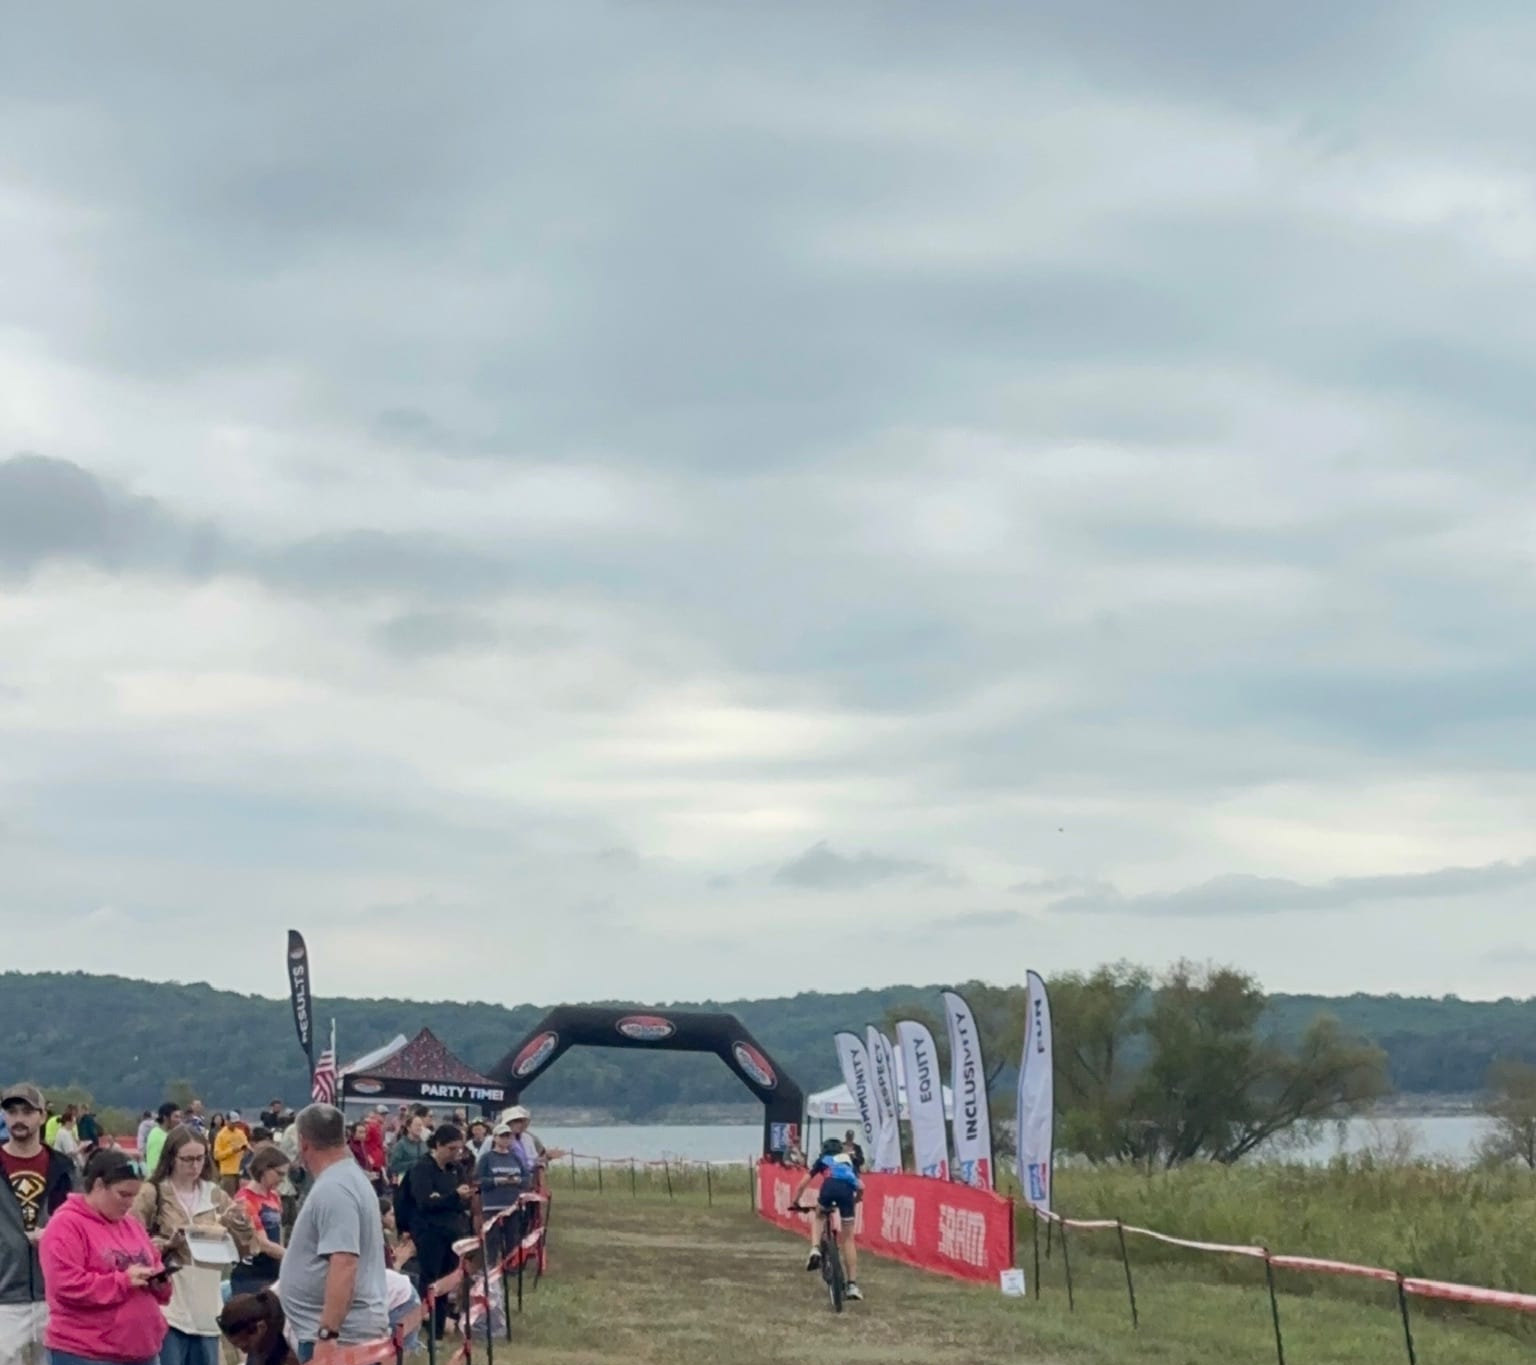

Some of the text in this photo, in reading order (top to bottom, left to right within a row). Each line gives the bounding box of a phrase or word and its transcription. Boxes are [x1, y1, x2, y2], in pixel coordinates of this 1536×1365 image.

[421, 1084, 504, 1102] PARTY TIME!
[850, 1049, 872, 1144] COMMUNITY
[913, 1038, 932, 1103] EQUITY
[955, 1012, 977, 1141] INCLUSIVITY
